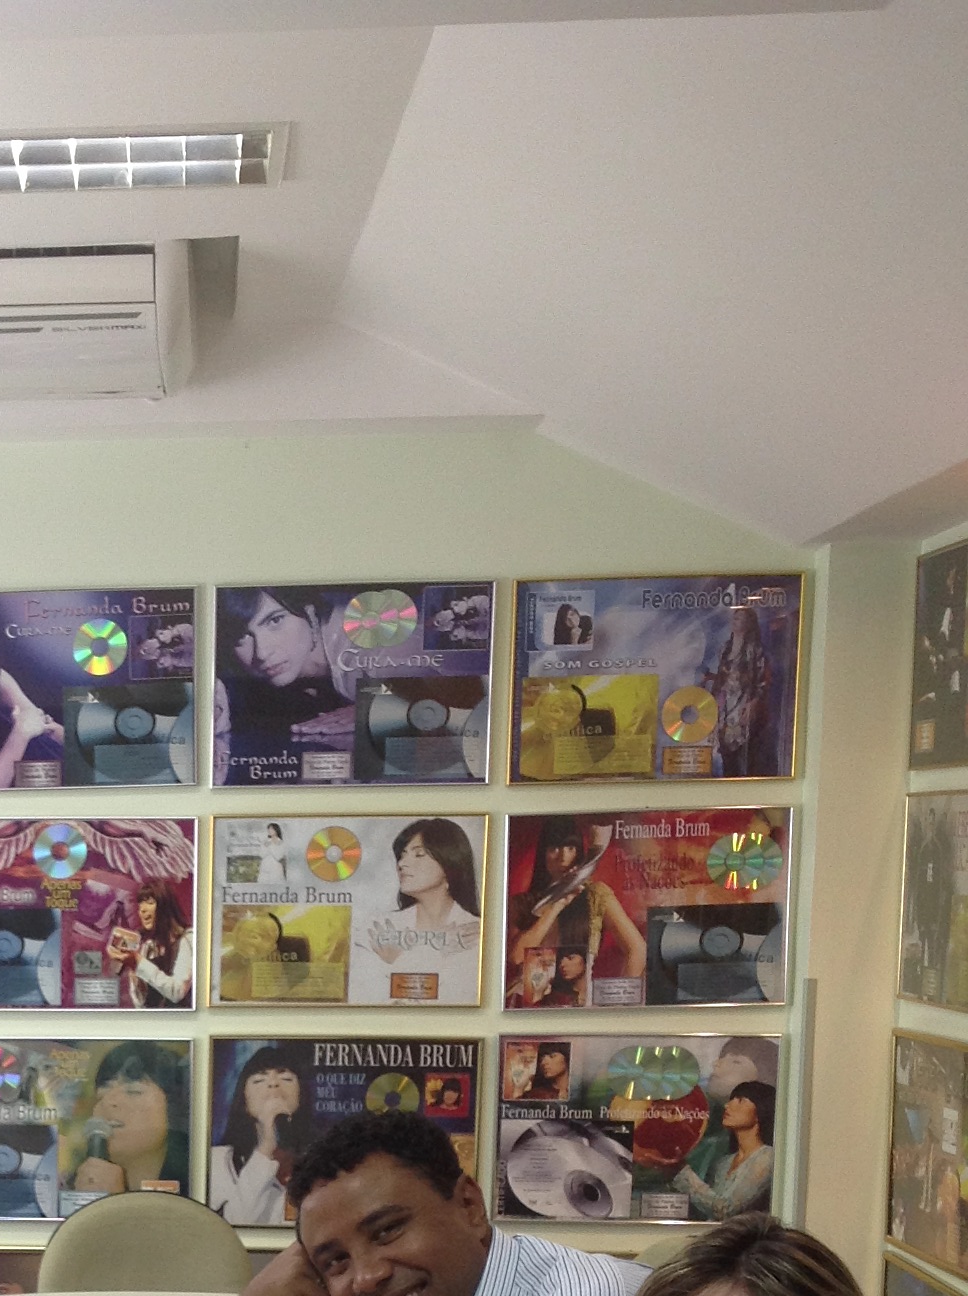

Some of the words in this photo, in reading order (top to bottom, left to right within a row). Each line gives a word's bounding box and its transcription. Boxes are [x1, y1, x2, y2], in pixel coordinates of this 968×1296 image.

[642, 588, 730, 610] Fernanda
[24, 596, 123, 623] Fernanda
[132, 596, 190, 615] Brum
[543, 659, 582, 670] SOM
[588, 657, 658, 669] GOSPEL
[249, 765, 298, 779] Brum
[614, 818, 672, 840] Fernanda
[675, 817, 711, 838] Brum
[221, 886, 299, 904] Fernanda
[305, 886, 353, 904] Brum
[313, 1042, 414, 1067] FERNANDA
[419, 1044, 474, 1068] BRUM
[18, 1103, 59, 1120] Brum
[501, 1104, 555, 1119] Fernanda
[560, 1104, 593, 1119] Brum
[674, 1105, 710, 1122] Nações
